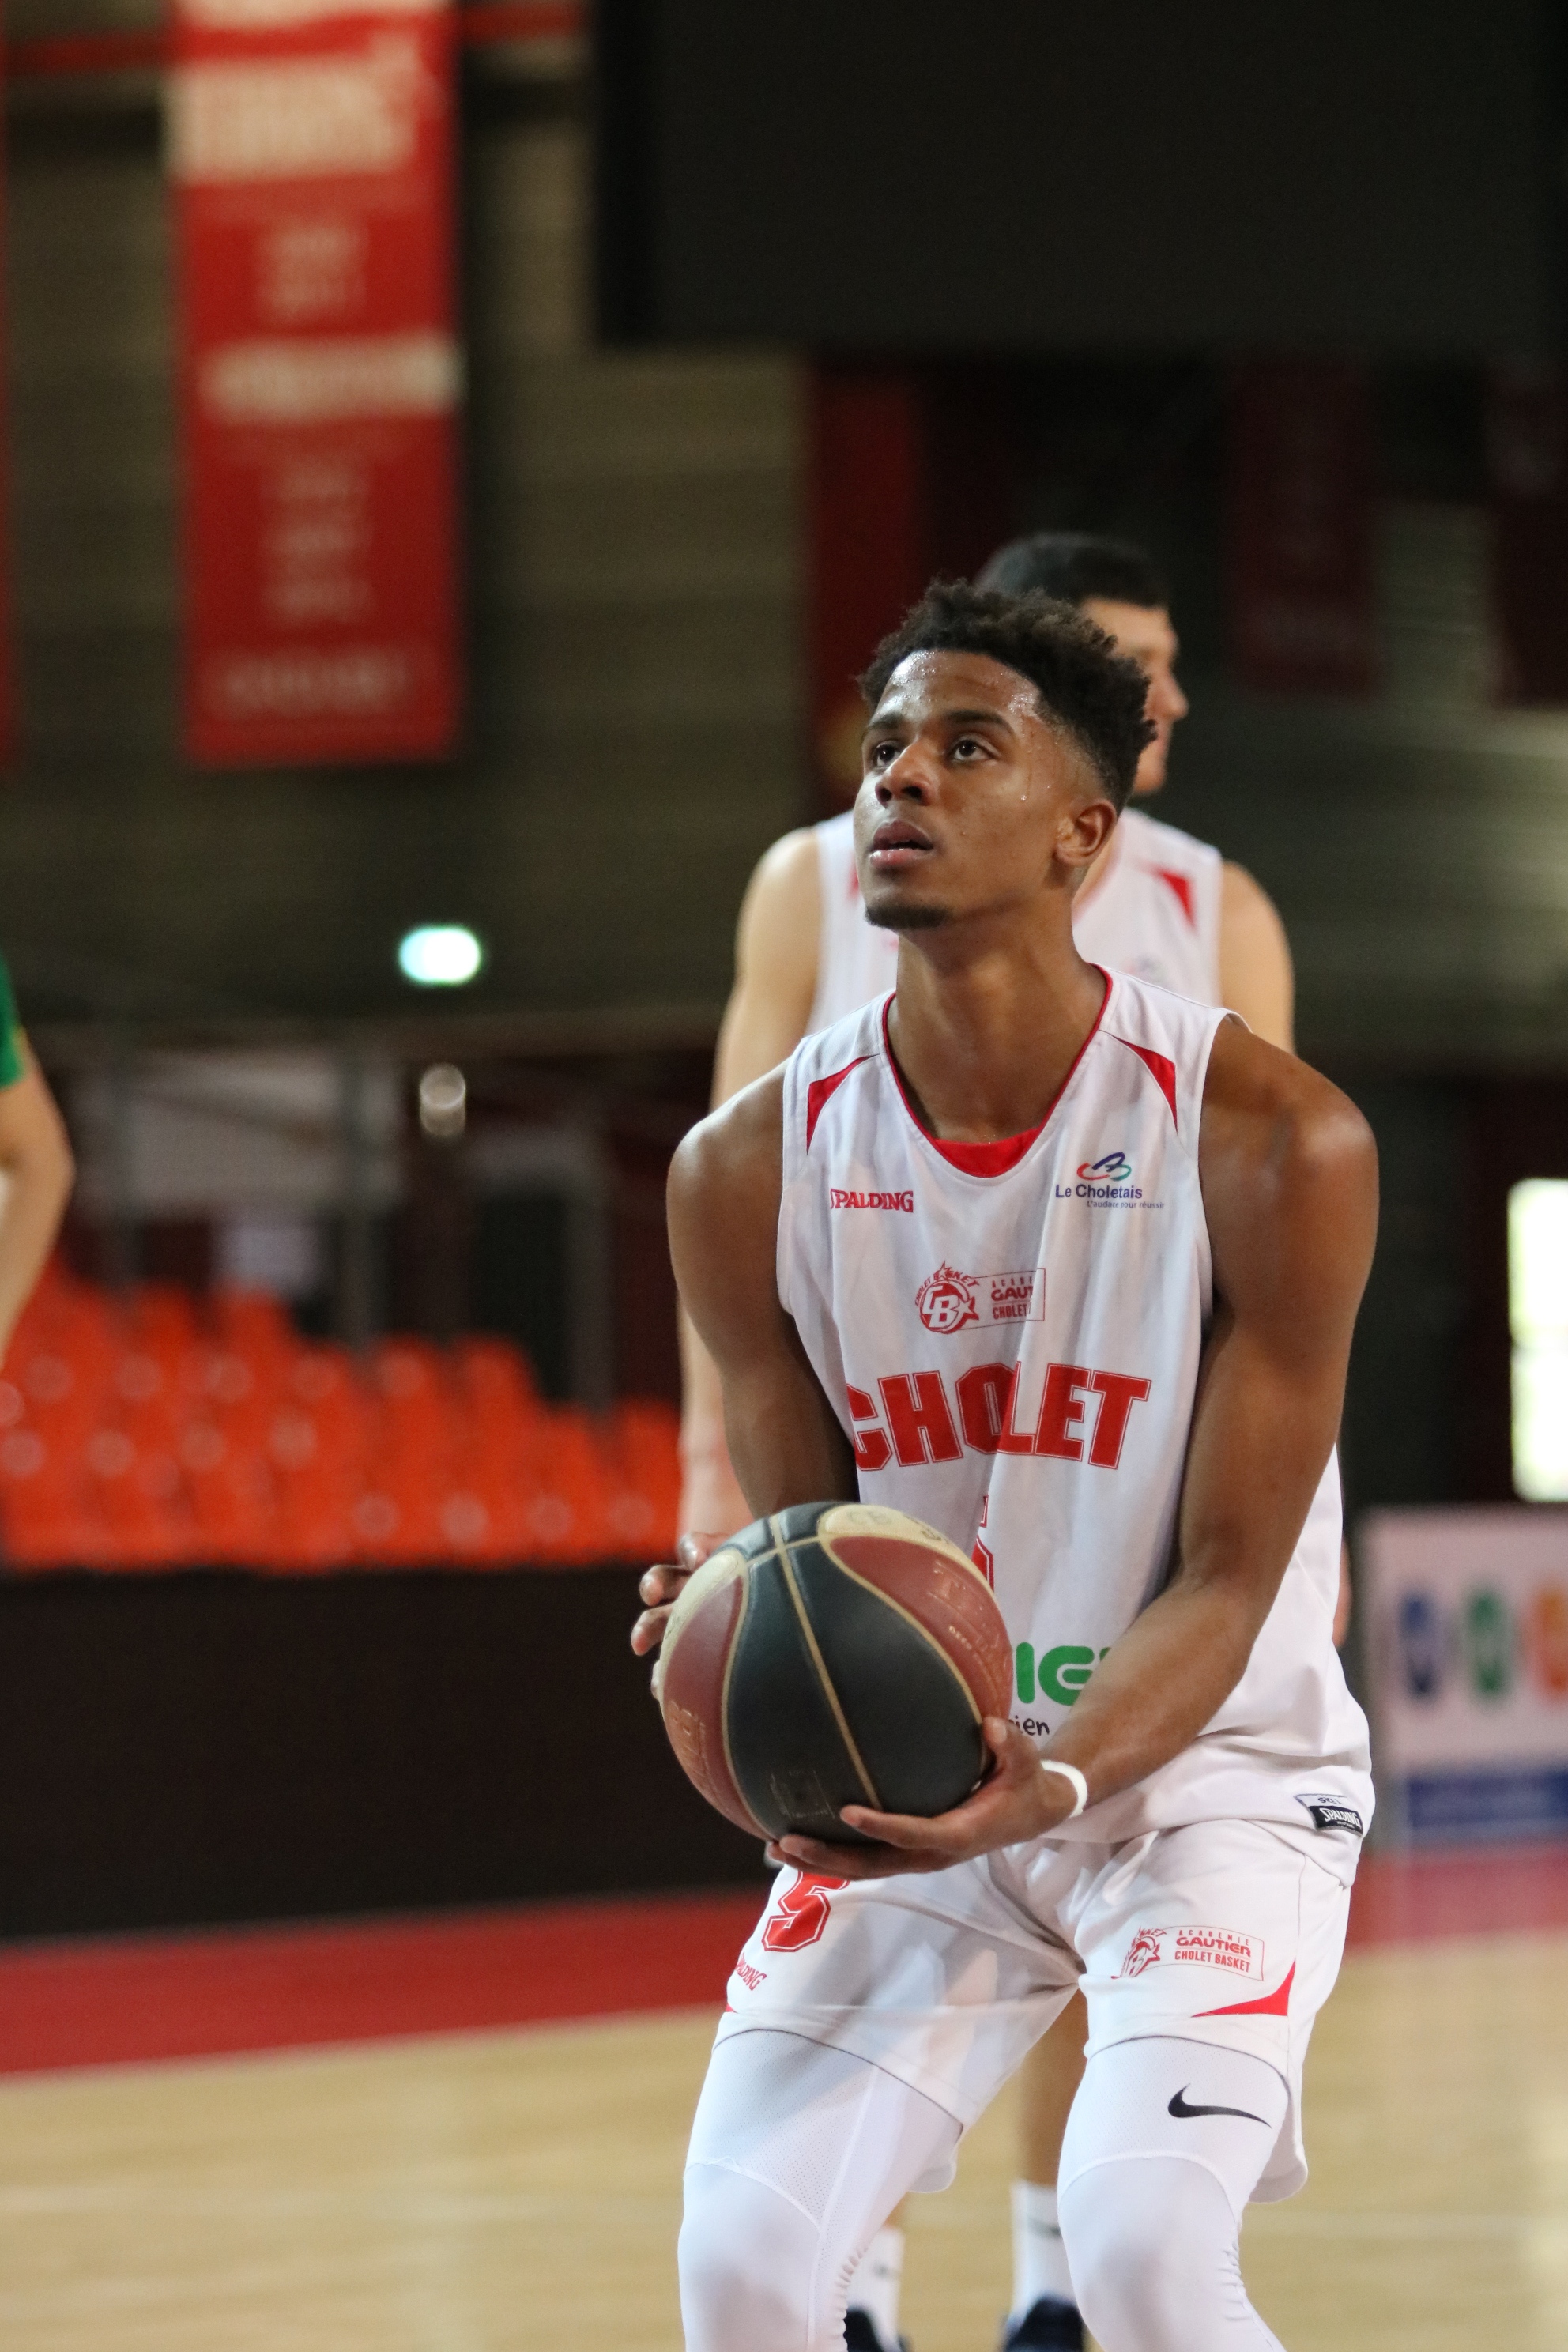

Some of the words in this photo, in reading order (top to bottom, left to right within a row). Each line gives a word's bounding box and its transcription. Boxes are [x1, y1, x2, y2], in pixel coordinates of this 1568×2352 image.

[1055, 1184, 1072, 1198] Le
[1076, 1183, 1143, 1199] Choletais
[1087, 1200, 1119, 1208] L'audace
[1139, 1200, 1165, 1209] réussir
[993, 1304, 1027, 1320] CHOLET
[846, 1361, 1152, 1472] CHOLET
[1008, 1714, 1050, 1736] ien
[1319, 1807, 1362, 1830] SPALDING
[761, 1870, 851, 1952] 5
[1176, 1937, 1251, 1958] GAUTIER
[1174, 1951, 1212, 1963] CHOLET
[1215, 1953, 1251, 1973] BASKET
